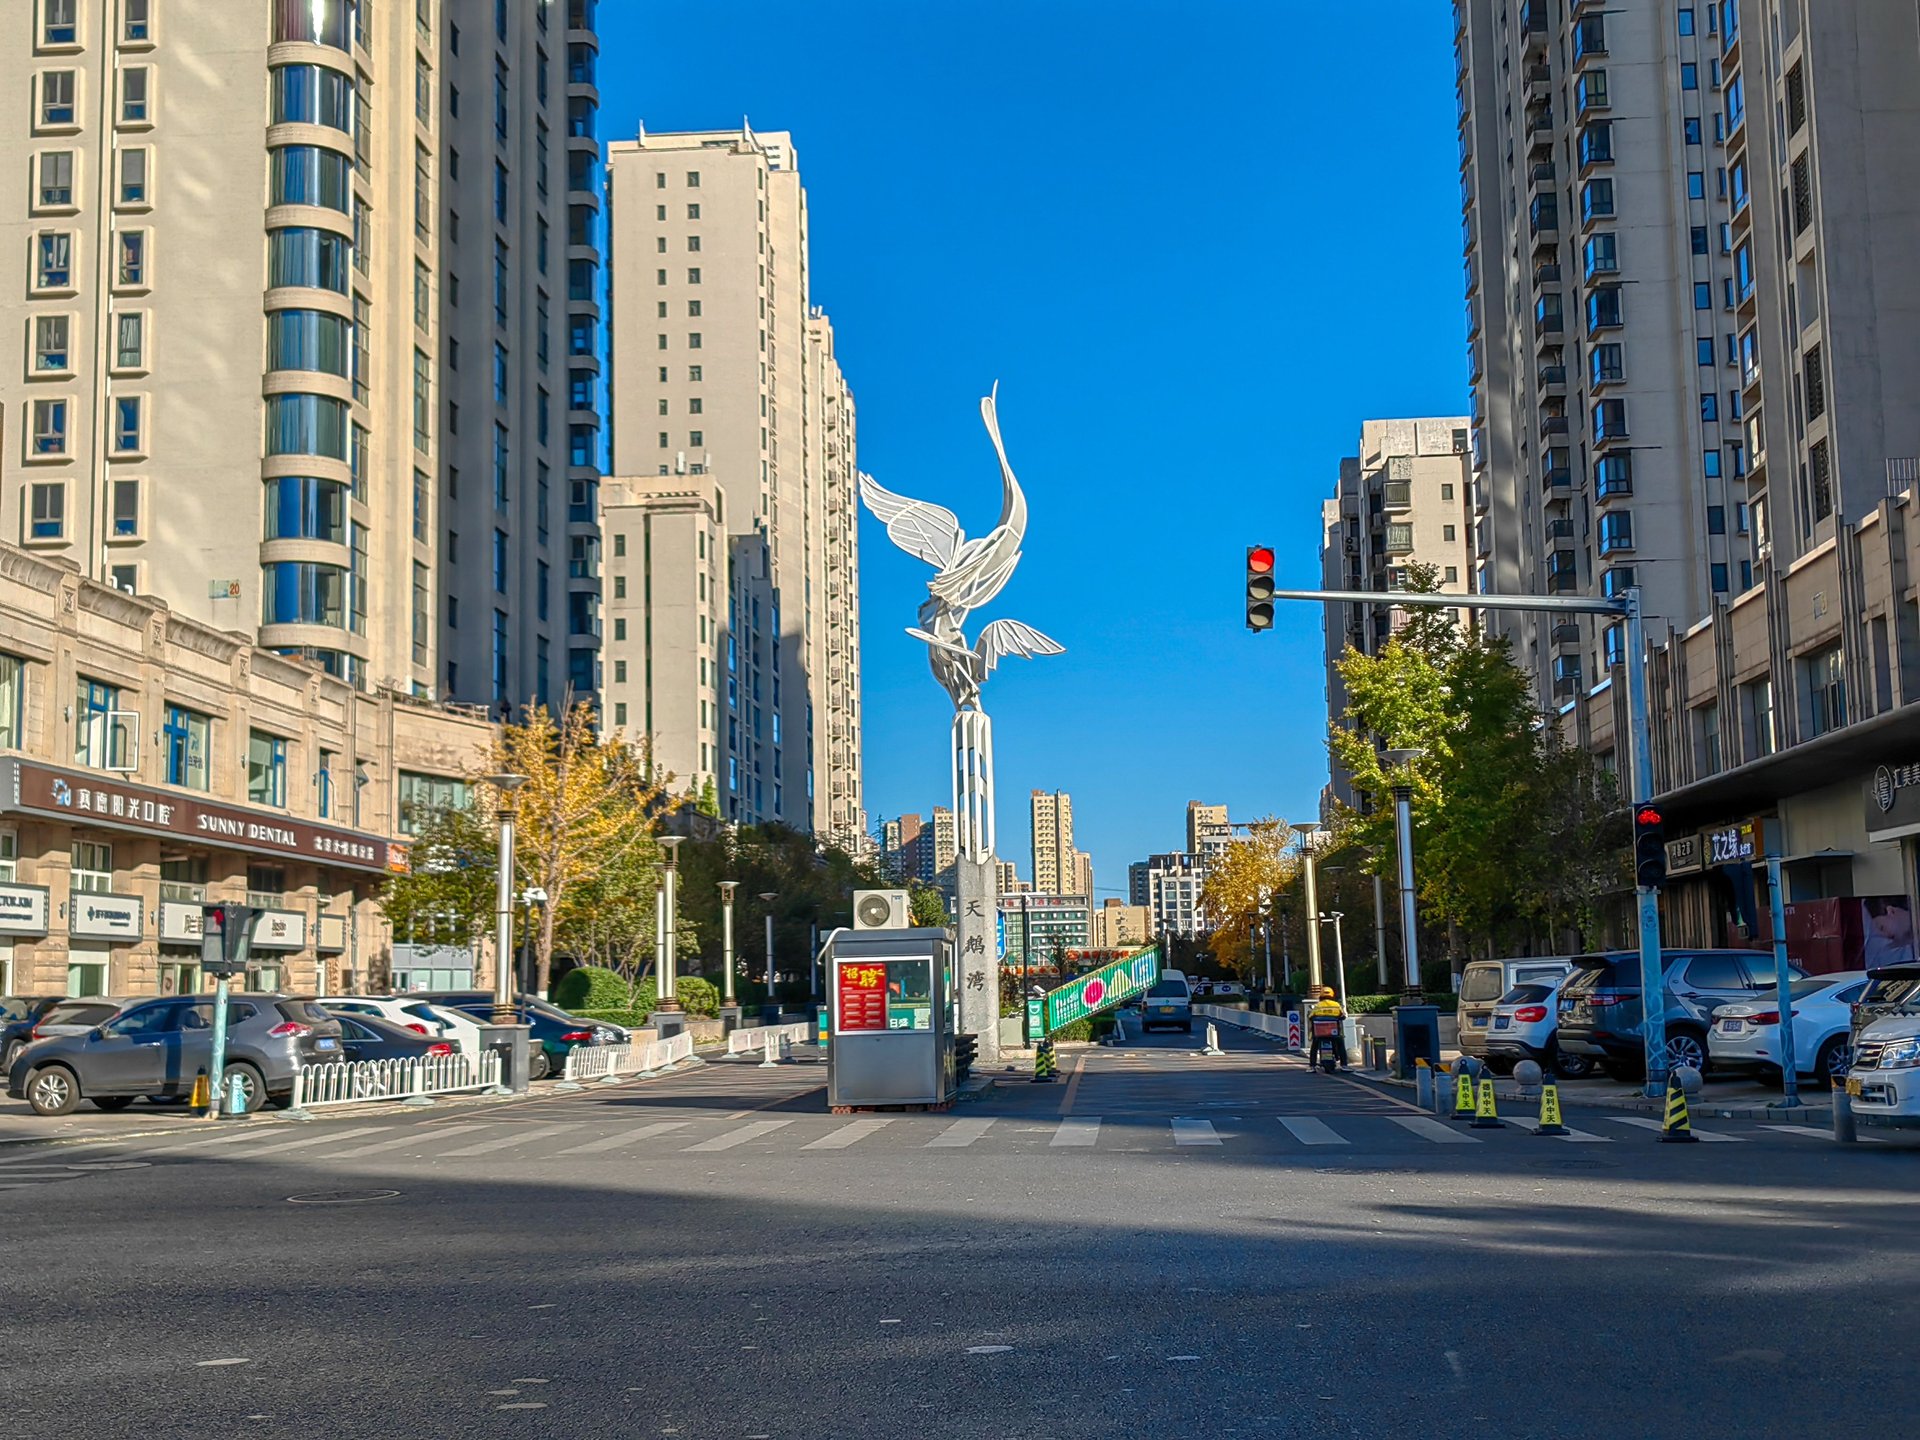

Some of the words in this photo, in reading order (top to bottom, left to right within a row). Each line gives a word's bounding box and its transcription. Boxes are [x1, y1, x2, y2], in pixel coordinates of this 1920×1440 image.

[229, 582, 240, 595] 20
[197, 814, 245, 837] SUNNY
[247, 823, 297, 847] DENTAL
[964, 900, 986, 992] 天鹅湾
[845, 966, 878, 987] 招聘
